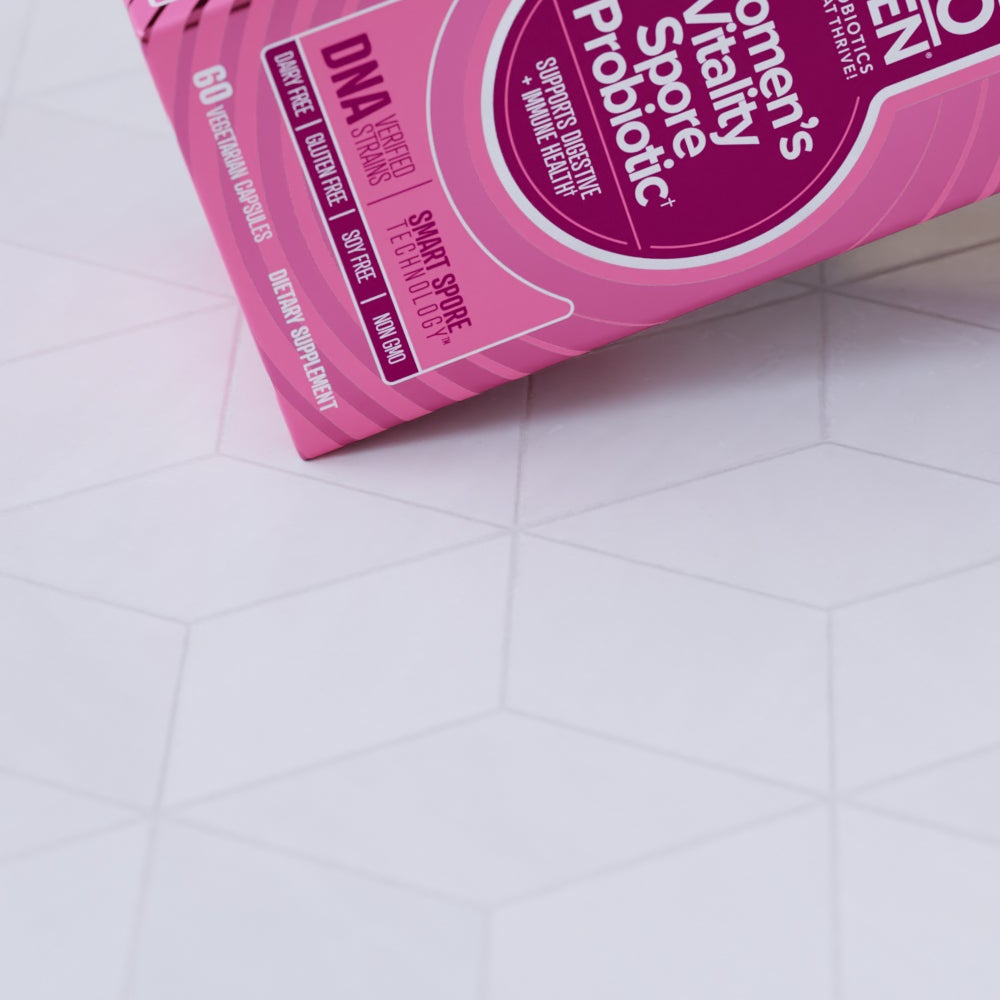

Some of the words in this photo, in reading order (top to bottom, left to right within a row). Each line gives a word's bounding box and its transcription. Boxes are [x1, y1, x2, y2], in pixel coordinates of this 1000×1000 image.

[274, 50, 304, 86] DAIRY
[321, 33, 392, 125] DNA
[830, 16, 857, 79] THRIVE!
[193, 65, 233, 105] 60
[288, 85, 315, 117] FREE
[523, 76, 531, 84] +
[633, 17, 706, 158] Spore
[206, 105, 248, 180] VEGETARIAN
[374, 113, 416, 178] VERIFIED
[522, 88, 557, 144] IMMUNE
[536, 57, 577, 129] SUPPORTS
[561, 130, 601, 200] DIGESTIVE
[306, 133, 336, 178] GLUTEN
[323, 176, 347, 206] FREE
[351, 123, 392, 186] STRAINS
[234, 179, 273, 243] CAPSULES
[342, 230, 365, 253] SOY
[351, 254, 376, 283] FREE
[408, 210, 451, 271] SMART
[431, 273, 472, 334] SPORE
[268, 268, 305, 324] DIETARY
[291, 325, 338, 411] SUPPLEMENT
[373, 313, 396, 339] NON
[383, 338, 406, 364] GMO
